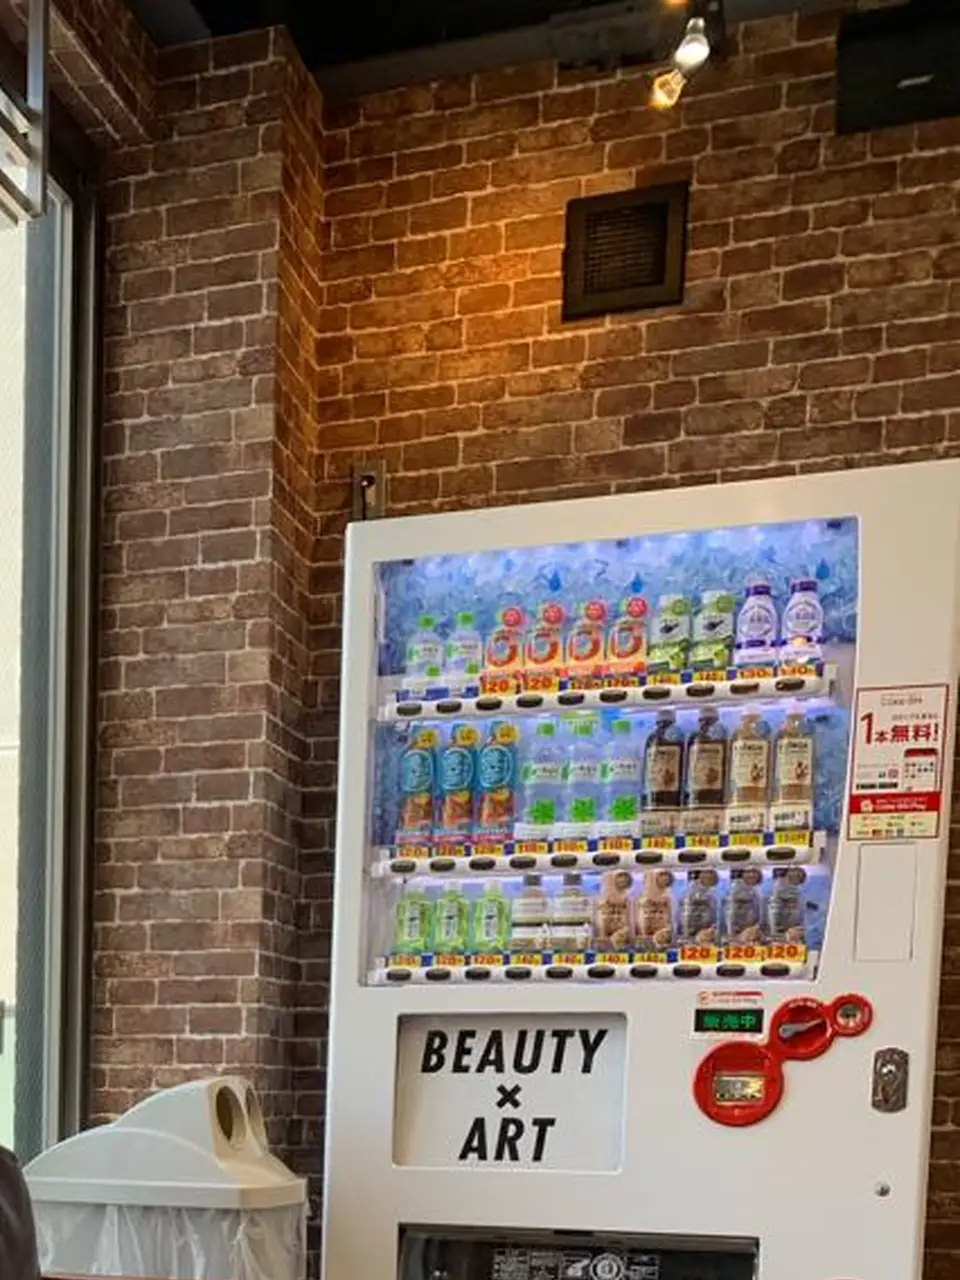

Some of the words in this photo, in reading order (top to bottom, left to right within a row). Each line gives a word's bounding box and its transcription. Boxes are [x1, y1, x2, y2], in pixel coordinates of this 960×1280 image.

[725, 945, 756, 959] 120
[767, 944, 798, 958] 120
[420, 1029, 609, 1075] BEAUTY
[458, 1116, 557, 1163] ART
